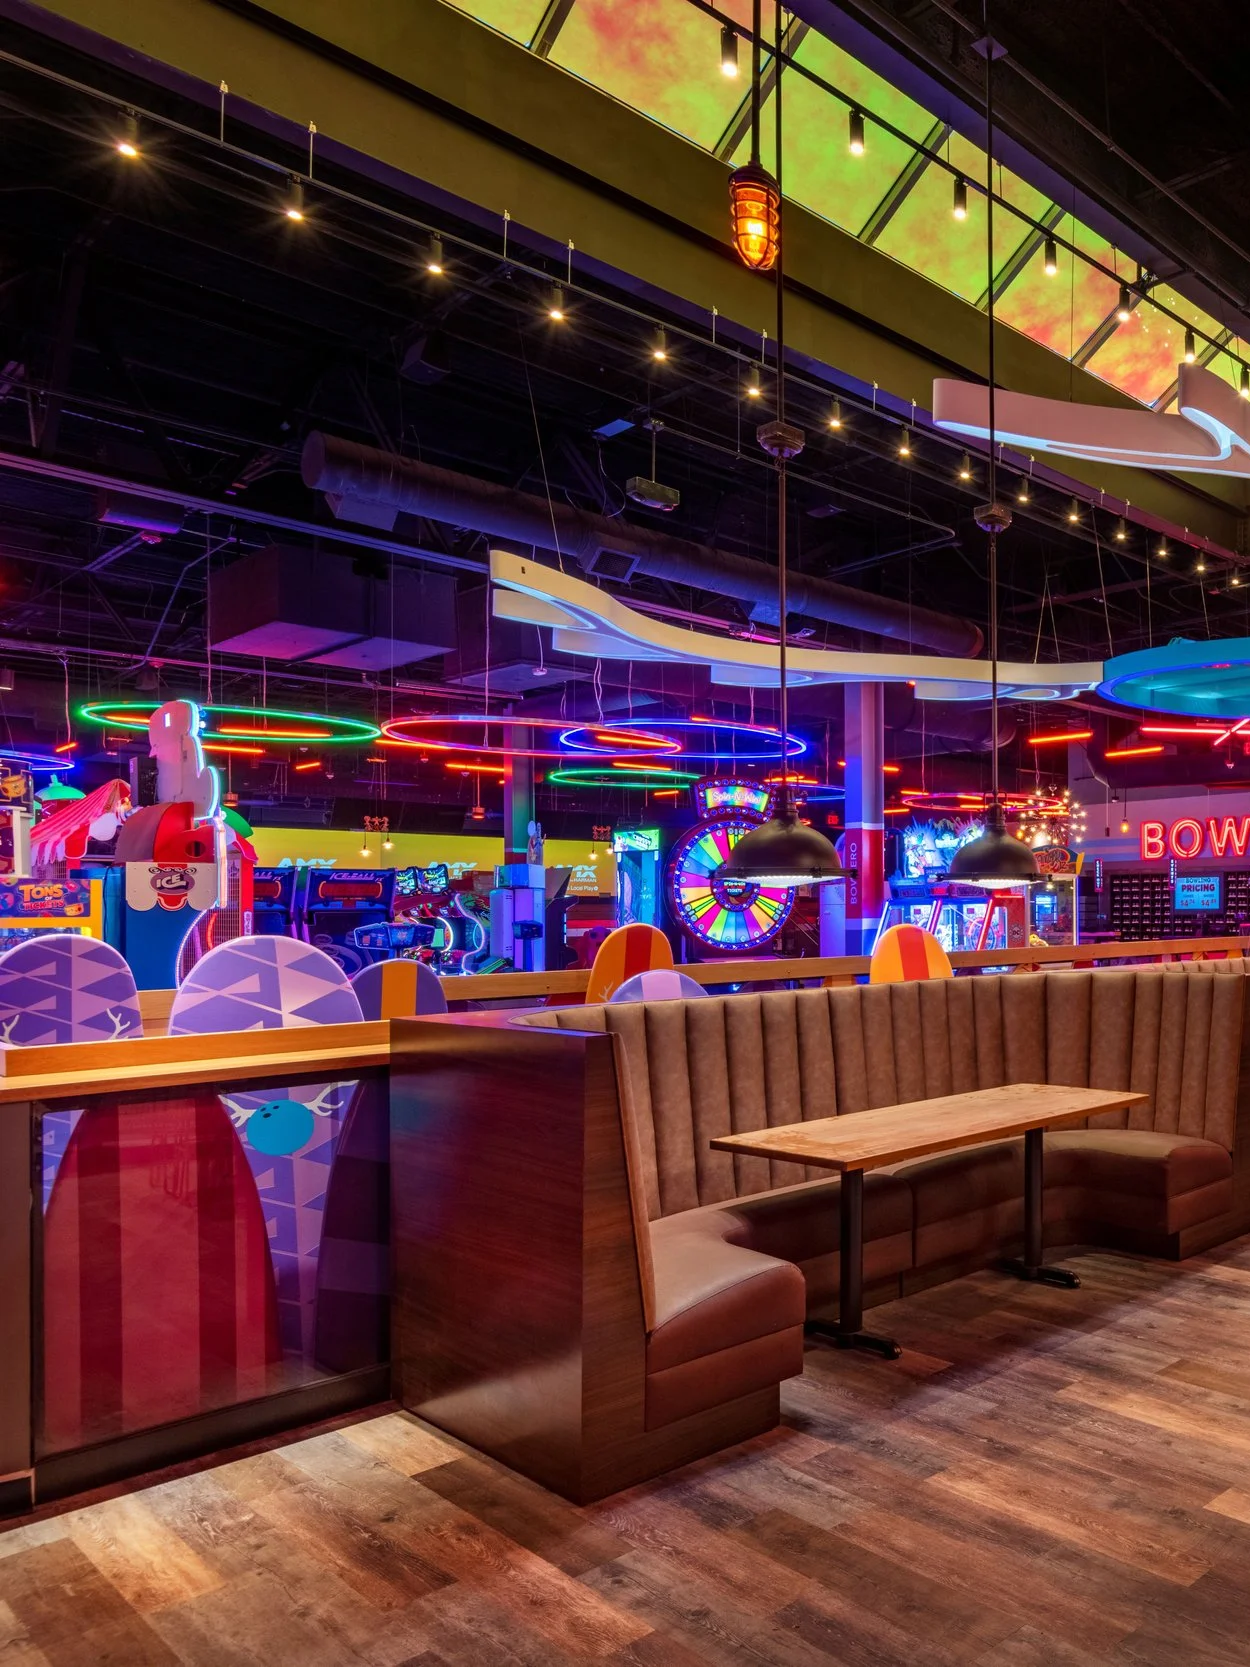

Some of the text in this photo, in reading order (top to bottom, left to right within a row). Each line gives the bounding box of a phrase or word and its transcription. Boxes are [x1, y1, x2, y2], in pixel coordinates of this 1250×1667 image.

[156, 873, 187, 890] ICE
[1181, 883, 1215, 892] PRICING
[18, 884, 64, 901] TONS
[22, 900, 65, 911] TICKETS
